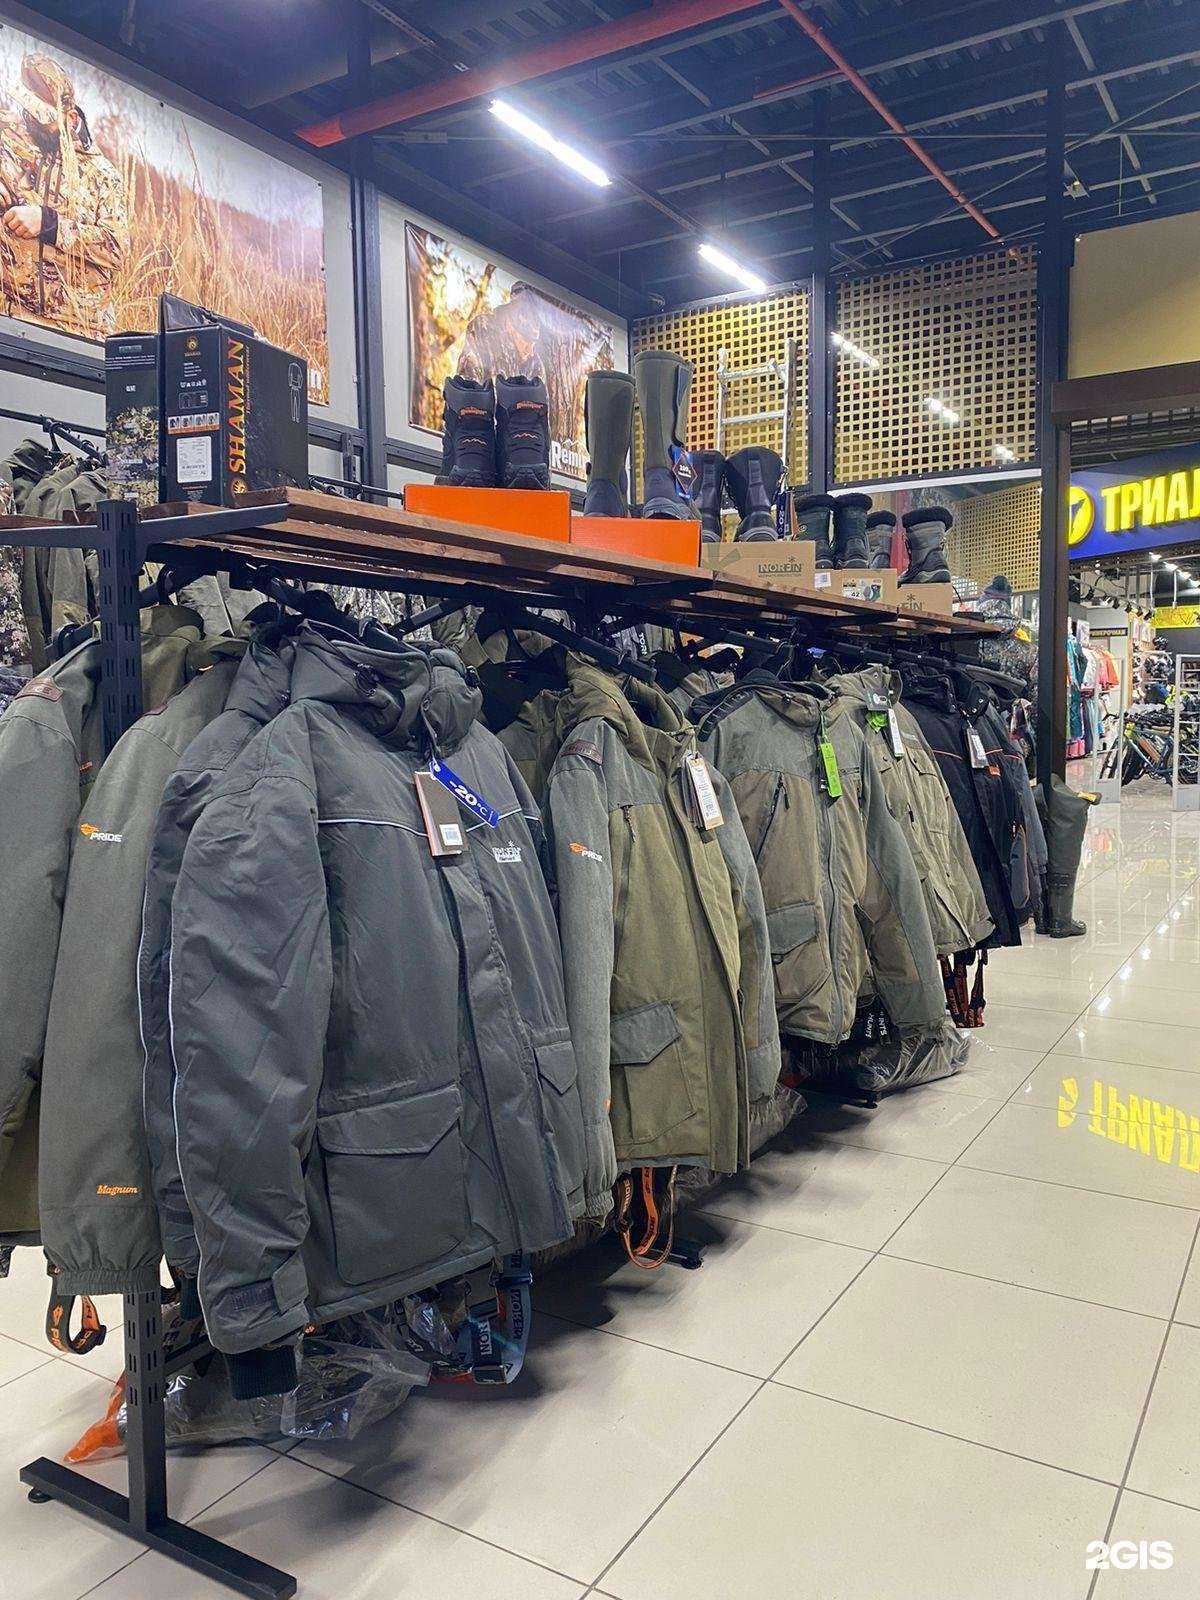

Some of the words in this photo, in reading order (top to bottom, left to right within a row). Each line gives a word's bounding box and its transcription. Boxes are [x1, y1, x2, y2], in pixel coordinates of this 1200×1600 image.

[227, 338, 246, 474] SHAMAN
[90, 832, 122, 842] PRIDE
[97, 1184, 138, 1196] Magnum
